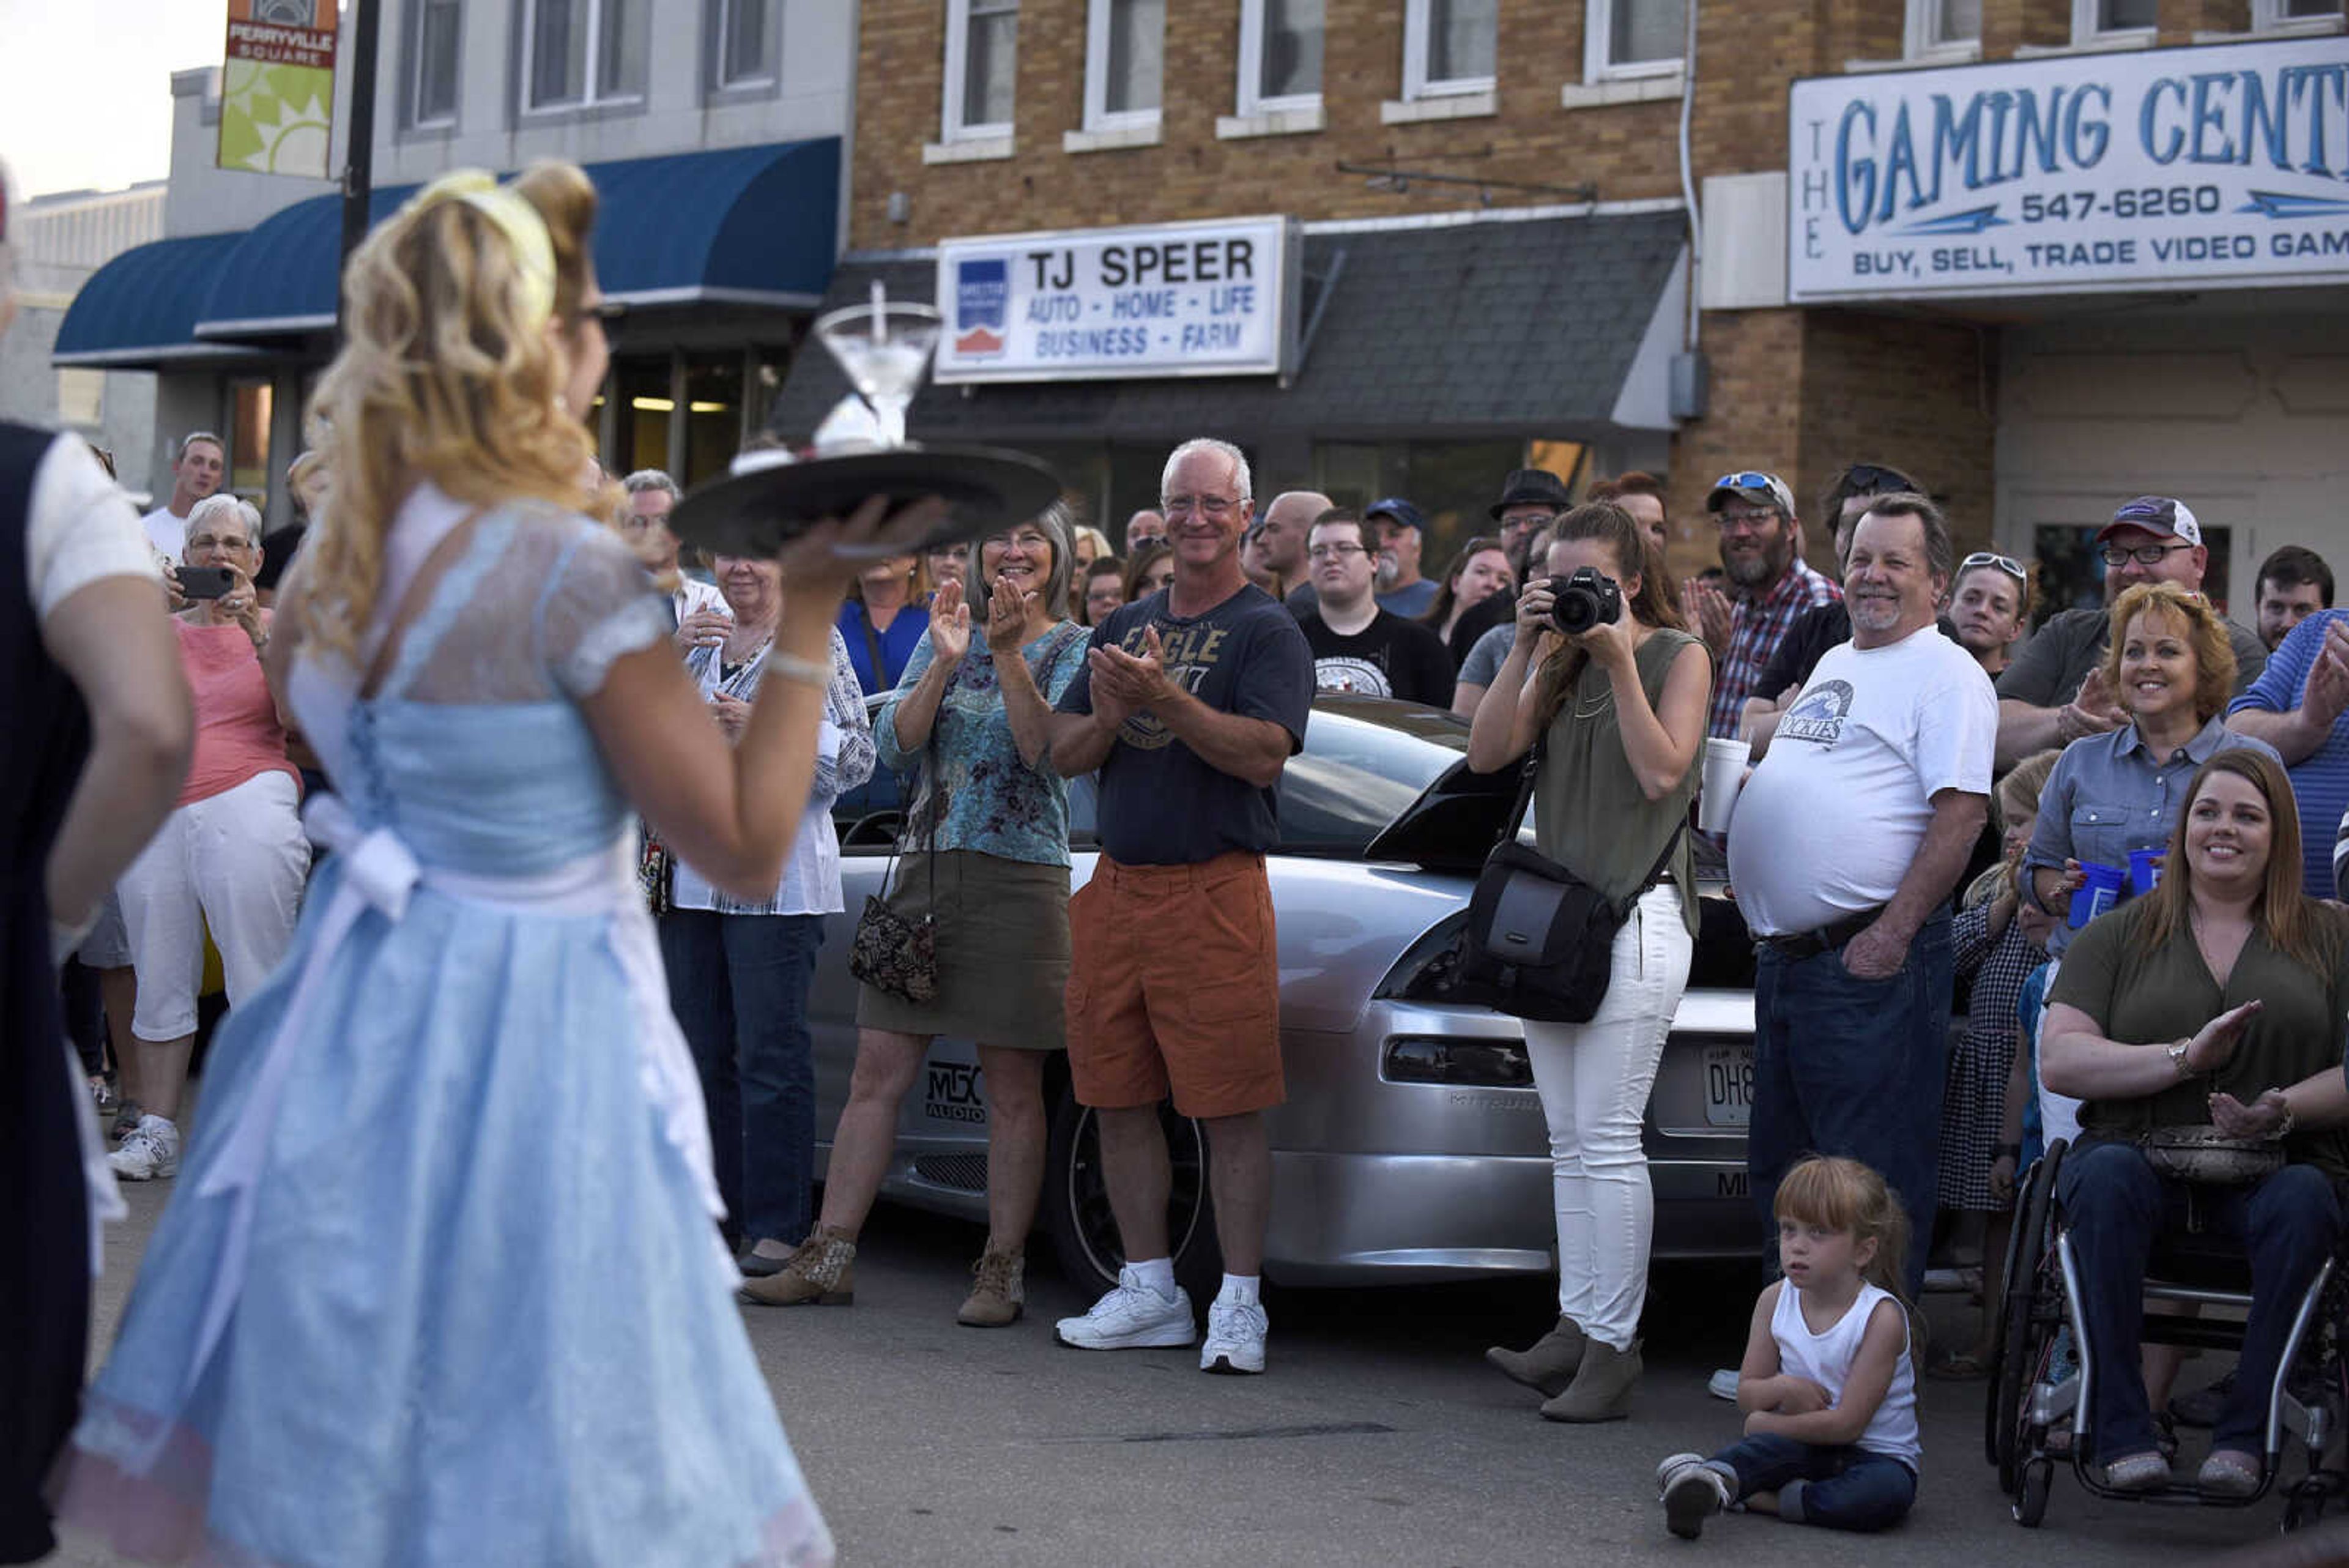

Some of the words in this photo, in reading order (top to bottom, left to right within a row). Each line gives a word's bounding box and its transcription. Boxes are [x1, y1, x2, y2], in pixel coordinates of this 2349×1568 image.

[231, 23, 332, 51] PERRYVILLE
[239, 43, 321, 65] SQUARE
[1835, 83, 2112, 235] GAMING
[2139, 62, 2349, 183] CENT
[2022, 185, 2220, 223] 547-6260
[1027, 250, 1074, 290] TJ
[1100, 239, 1253, 287] SPEER
[1854, 250, 1920, 277] BUY,
[1932, 247, 2014, 274] SELL,
[2025, 239, 2136, 267] TRADE
[2151, 234, 2256, 261] VIDEO
[1026, 293, 1082, 324] AUTO
[1112, 289, 1176, 319] HOME
[1209, 286, 1255, 316] LIFE
[1036, 326, 1148, 357] BUSINESS
[1181, 322, 1241, 351] FARM
[927, 1103, 986, 1123] AUDIO
